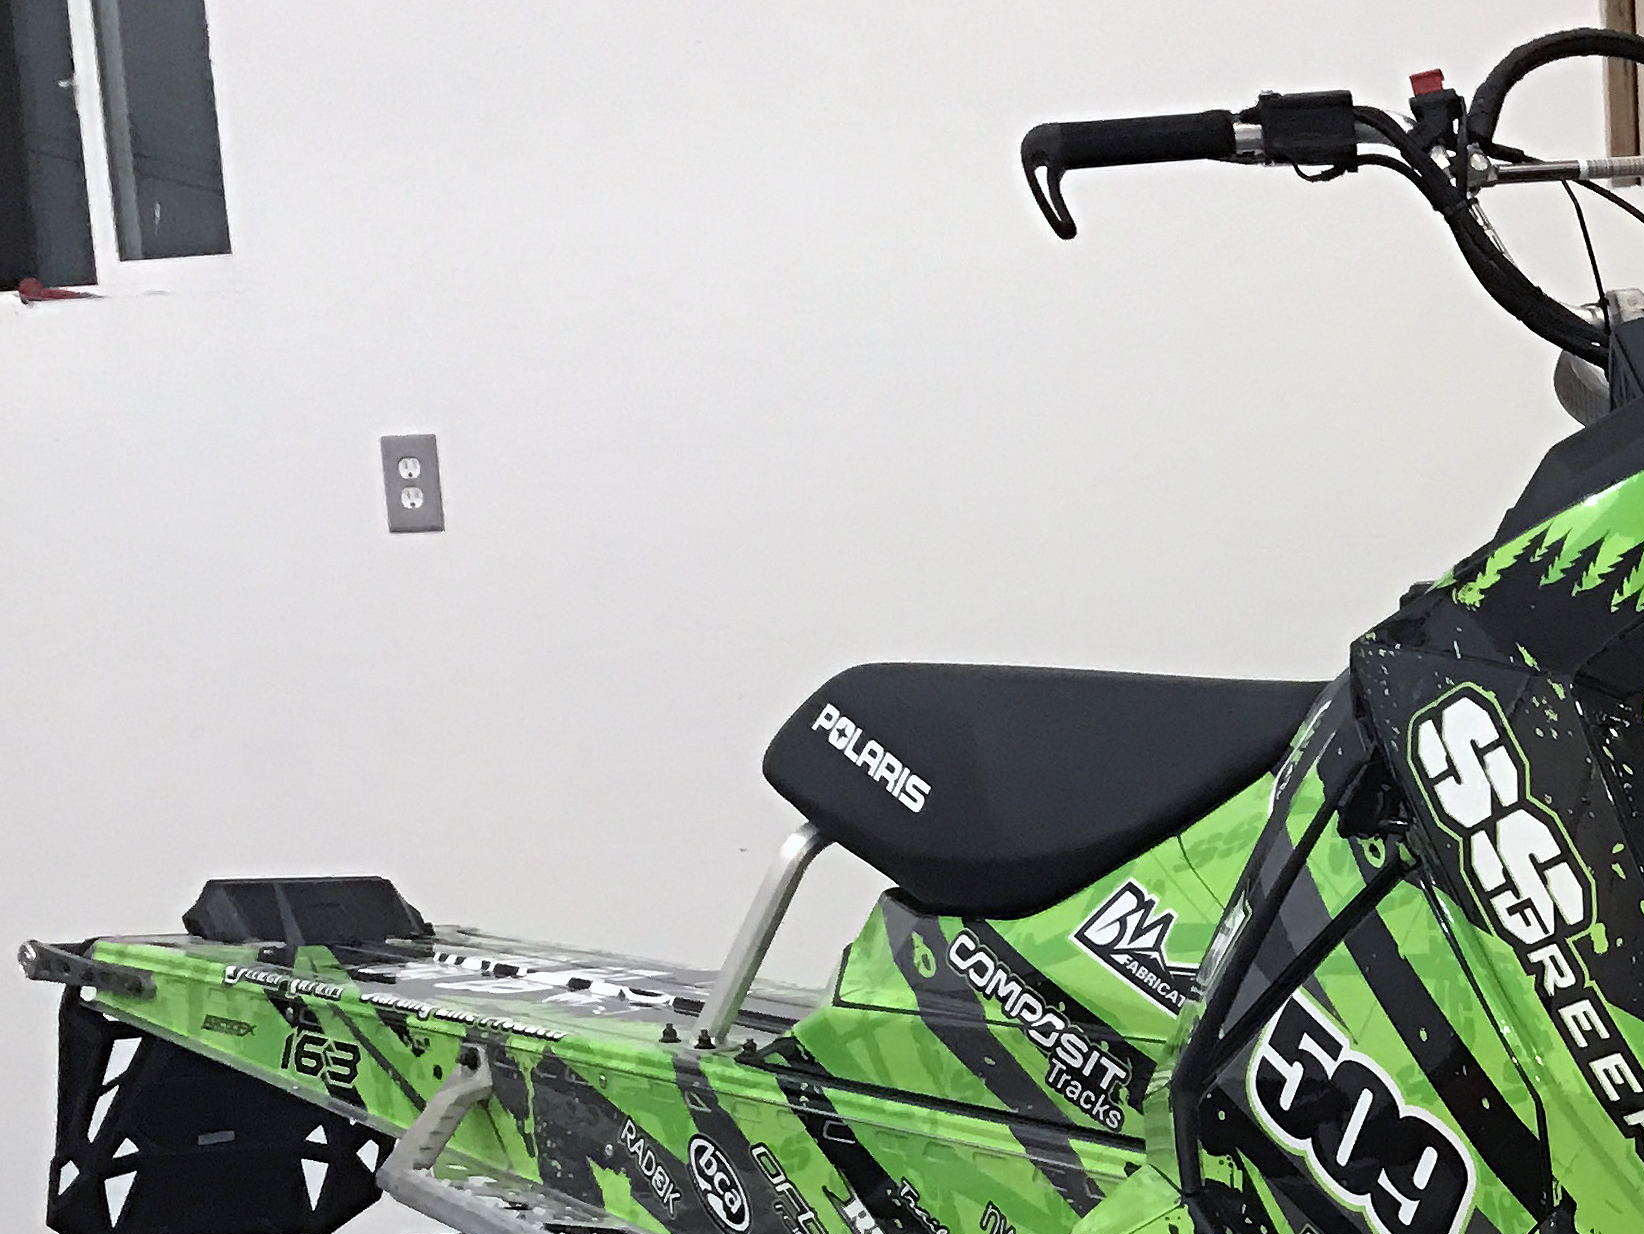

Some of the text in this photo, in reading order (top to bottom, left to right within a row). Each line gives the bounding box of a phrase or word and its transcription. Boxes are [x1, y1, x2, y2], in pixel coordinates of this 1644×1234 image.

[811, 703, 932, 814] POLARIS
[949, 933, 1127, 1091] COMPOSIT
[280, 1032, 362, 1085] 163
[1047, 1057, 1122, 1130] Tracks
[696, 1141, 746, 1221] bca
